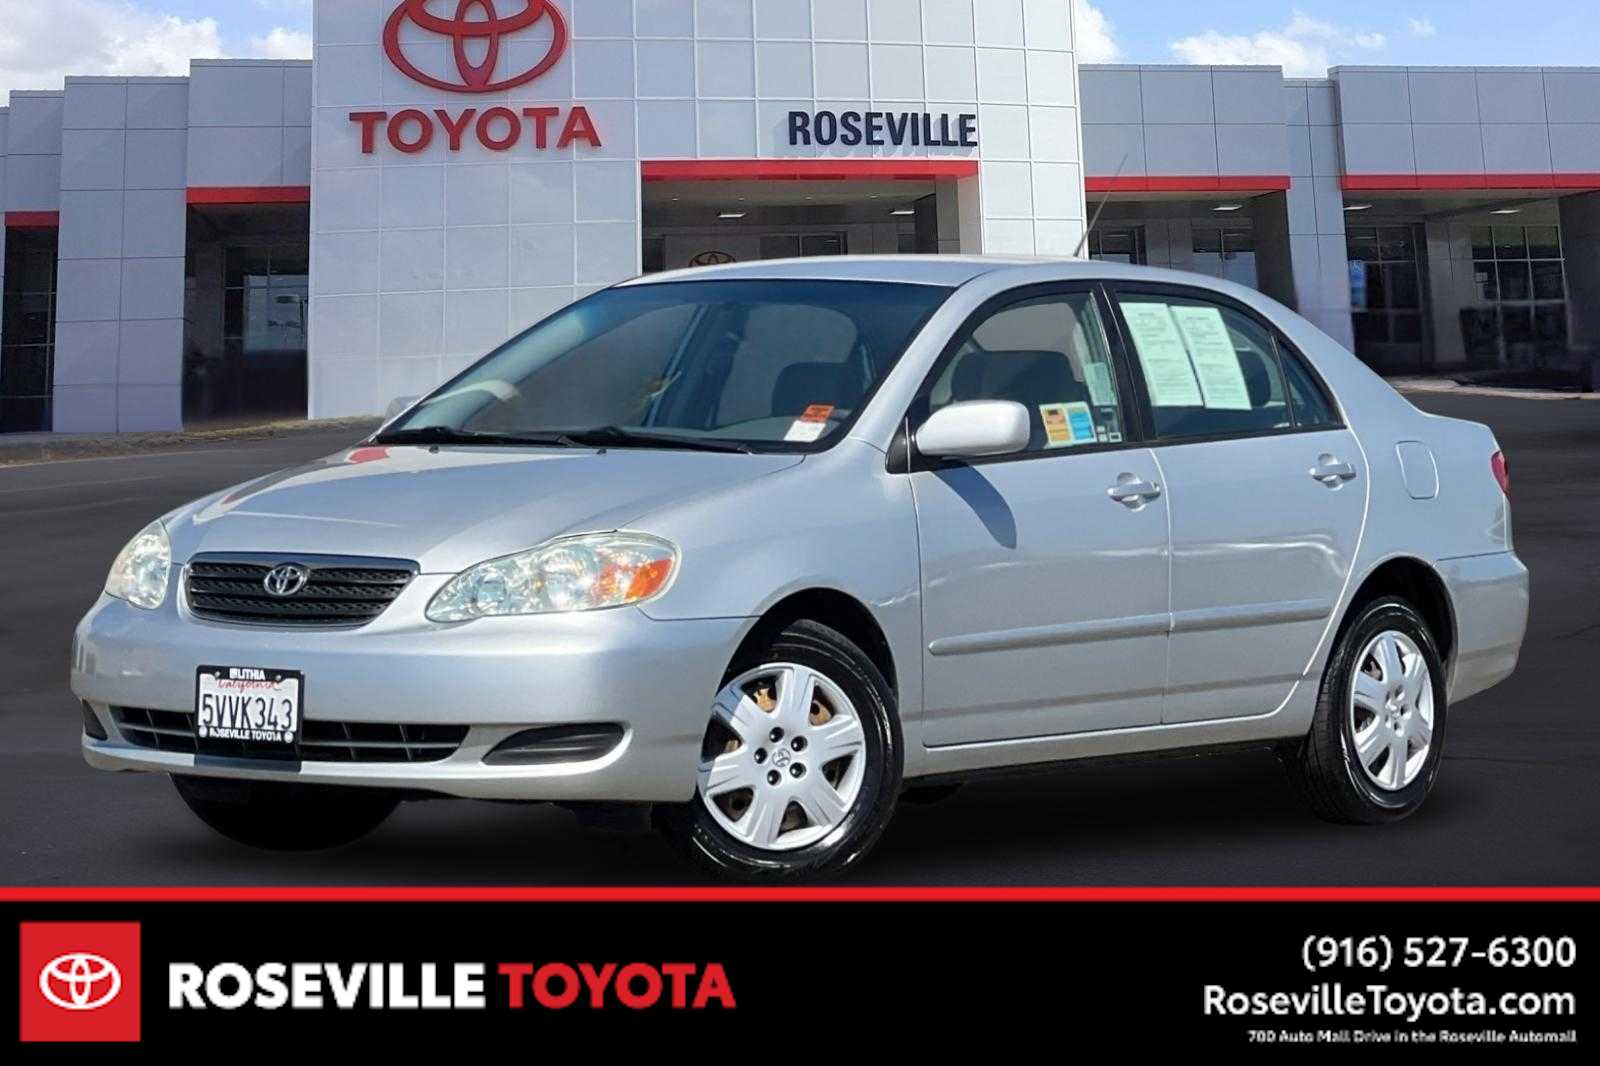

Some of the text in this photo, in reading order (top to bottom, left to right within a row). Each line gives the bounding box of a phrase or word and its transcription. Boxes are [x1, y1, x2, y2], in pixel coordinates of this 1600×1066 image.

[349, 105, 603, 154] TOYOTA
[788, 110, 978, 147] ROSEVILLE
[202, 693, 293, 730] 5VVK343
[209, 727, 282, 742] ROSEVILLE TOYOTA
